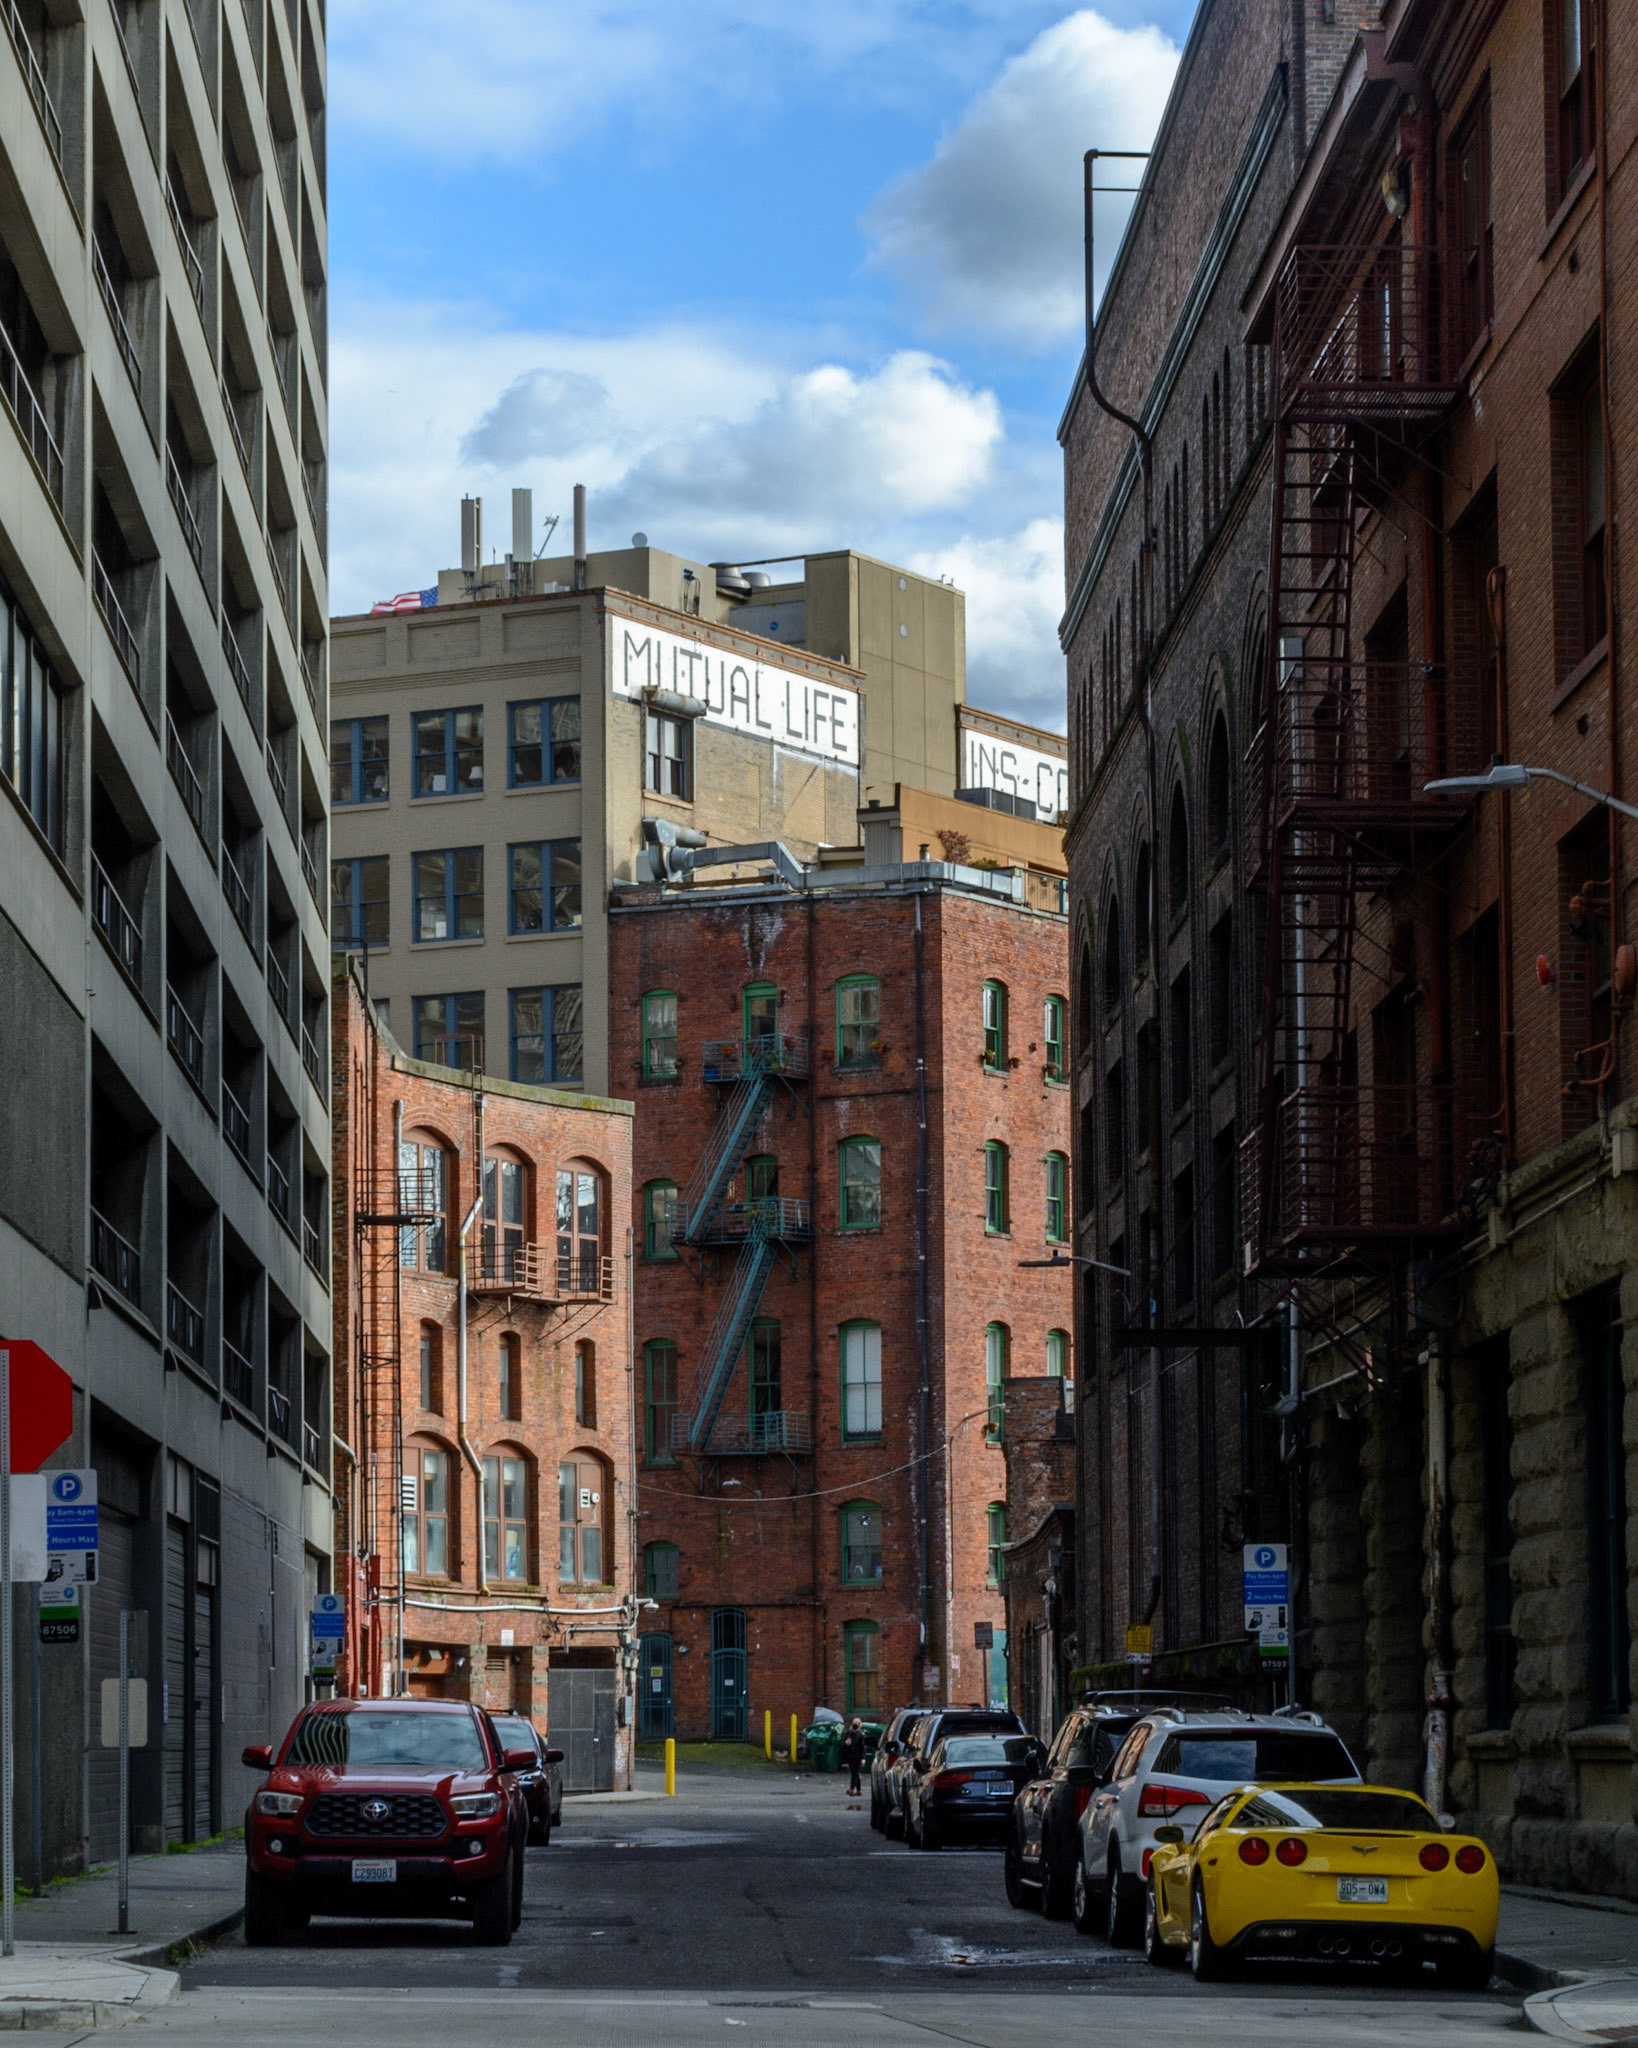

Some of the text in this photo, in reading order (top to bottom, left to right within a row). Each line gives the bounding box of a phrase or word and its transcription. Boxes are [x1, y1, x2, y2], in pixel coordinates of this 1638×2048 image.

[622, 629, 847, 753] MUTUAL LIFE
[61, 1479, 76, 1497] P
[57, 1508, 95, 1517] 8am-6pm
[52, 1536, 76, 1544] Hours
[78, 1535, 95, 1543] Max
[1260, 1551, 1271, 1564] P
[1247, 1591, 1253, 1600] 2
[326, 1599, 334, 1608] P
[42, 1625, 77, 1636] 87506
